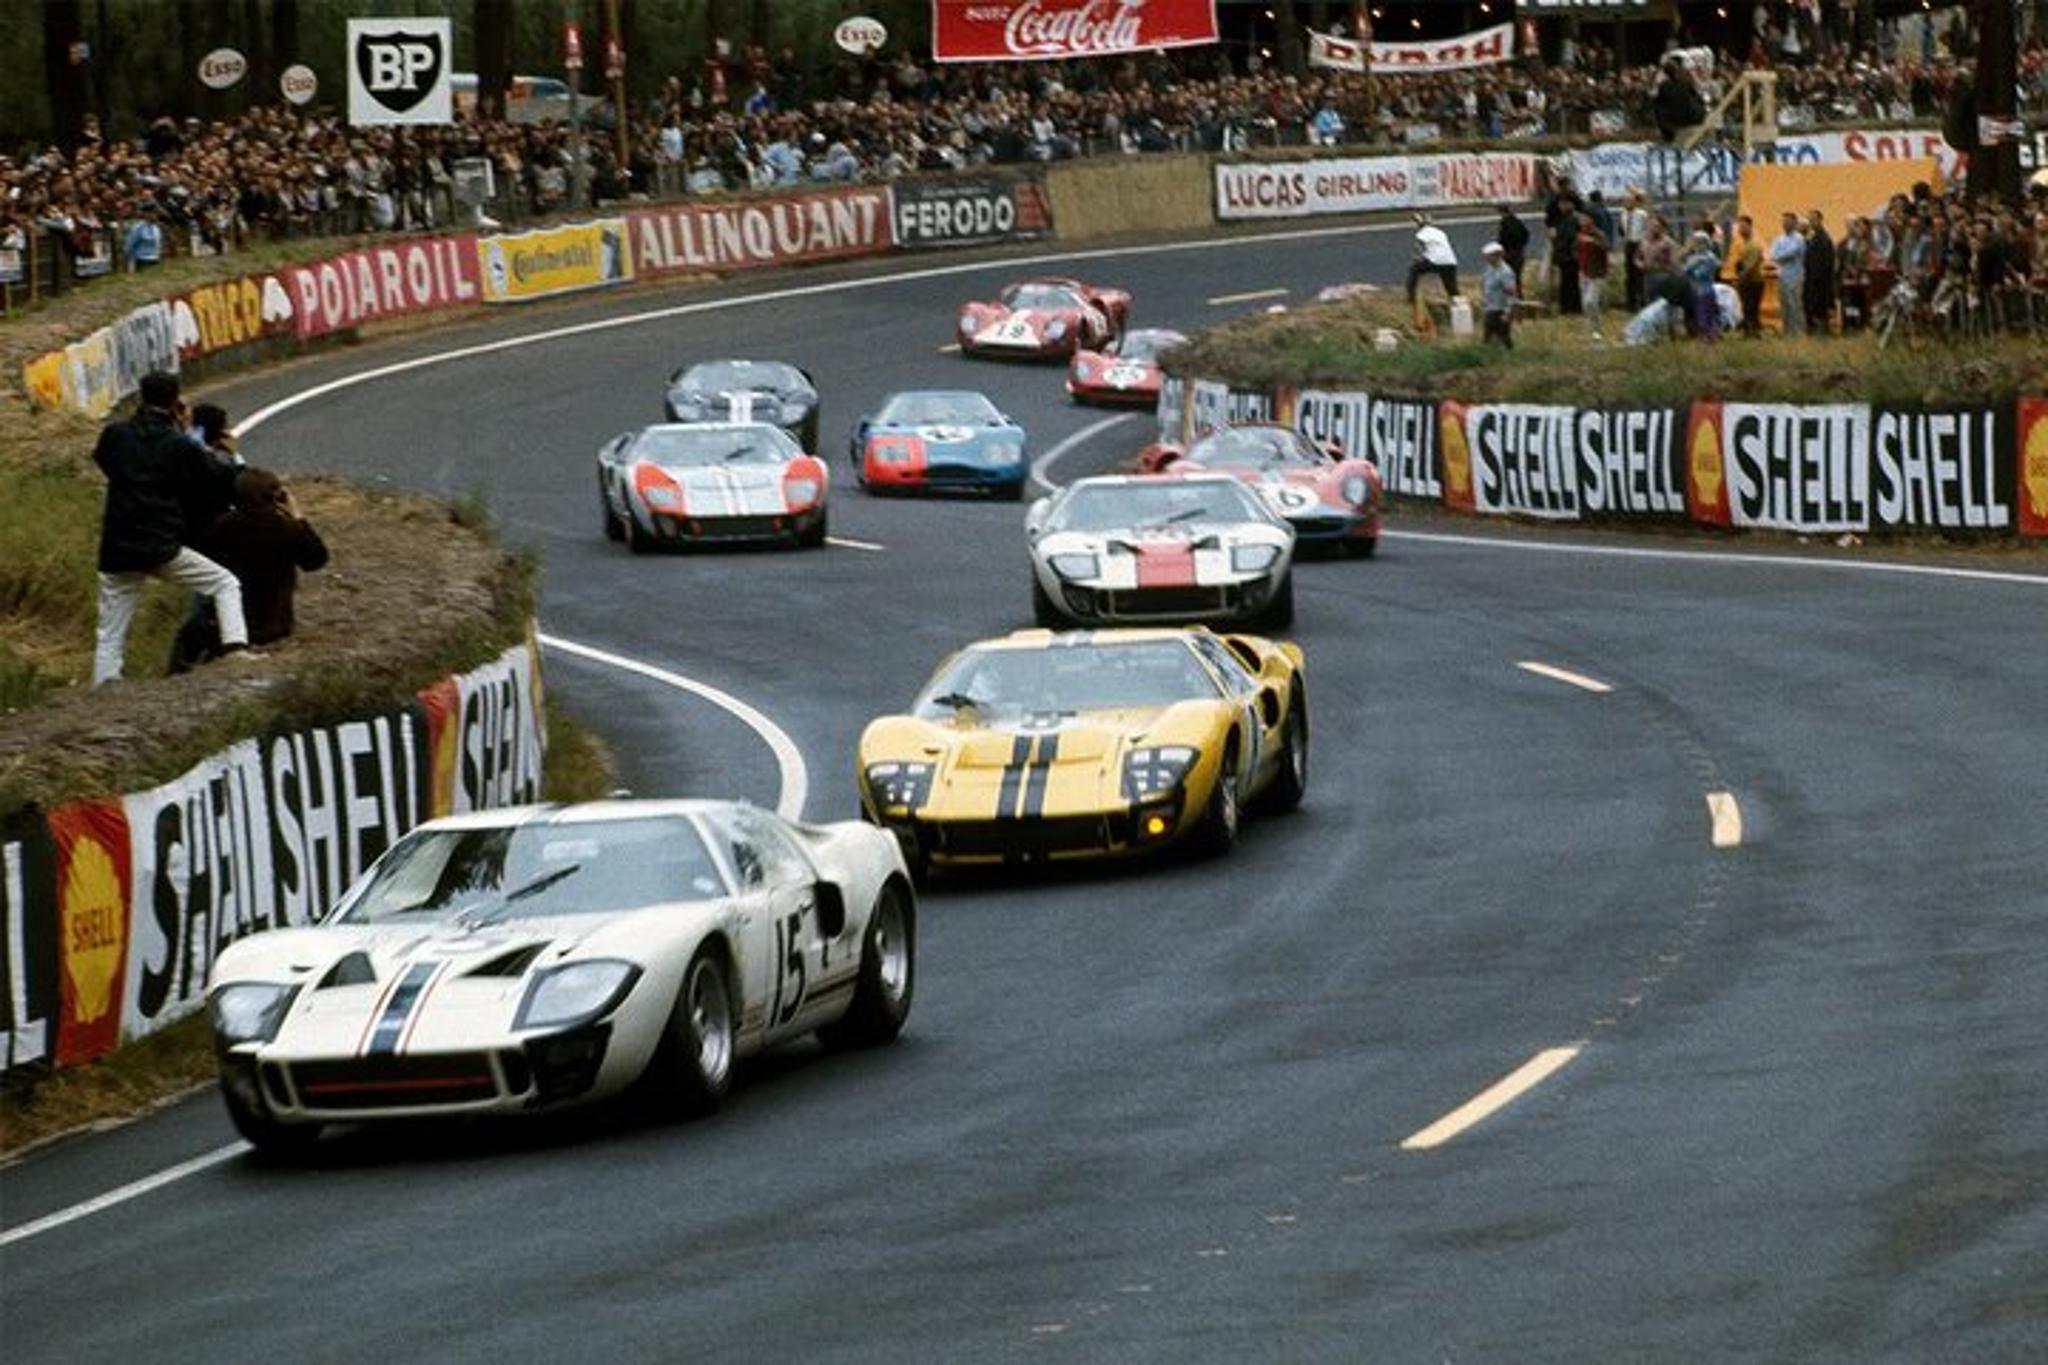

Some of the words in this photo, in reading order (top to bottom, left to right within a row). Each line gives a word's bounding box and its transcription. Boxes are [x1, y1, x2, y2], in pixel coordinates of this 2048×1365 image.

[369, 44, 434, 90] BP
[1224, 173, 1306, 207] LUCAS
[1316, 170, 1408, 198] GIRLING
[640, 196, 878, 269] ALLINQUANT
[900, 196, 1014, 239] FERODO
[1371, 400, 1441, 497] SHELL
[1478, 410, 1577, 508] SHELL
[1580, 410, 1684, 512] SHELL
[1734, 415, 1864, 522] SHELL
[1877, 412, 2009, 527] SHELL
[73, 906, 115, 953] SHELL
[770, 911, 806, 1028] 15
